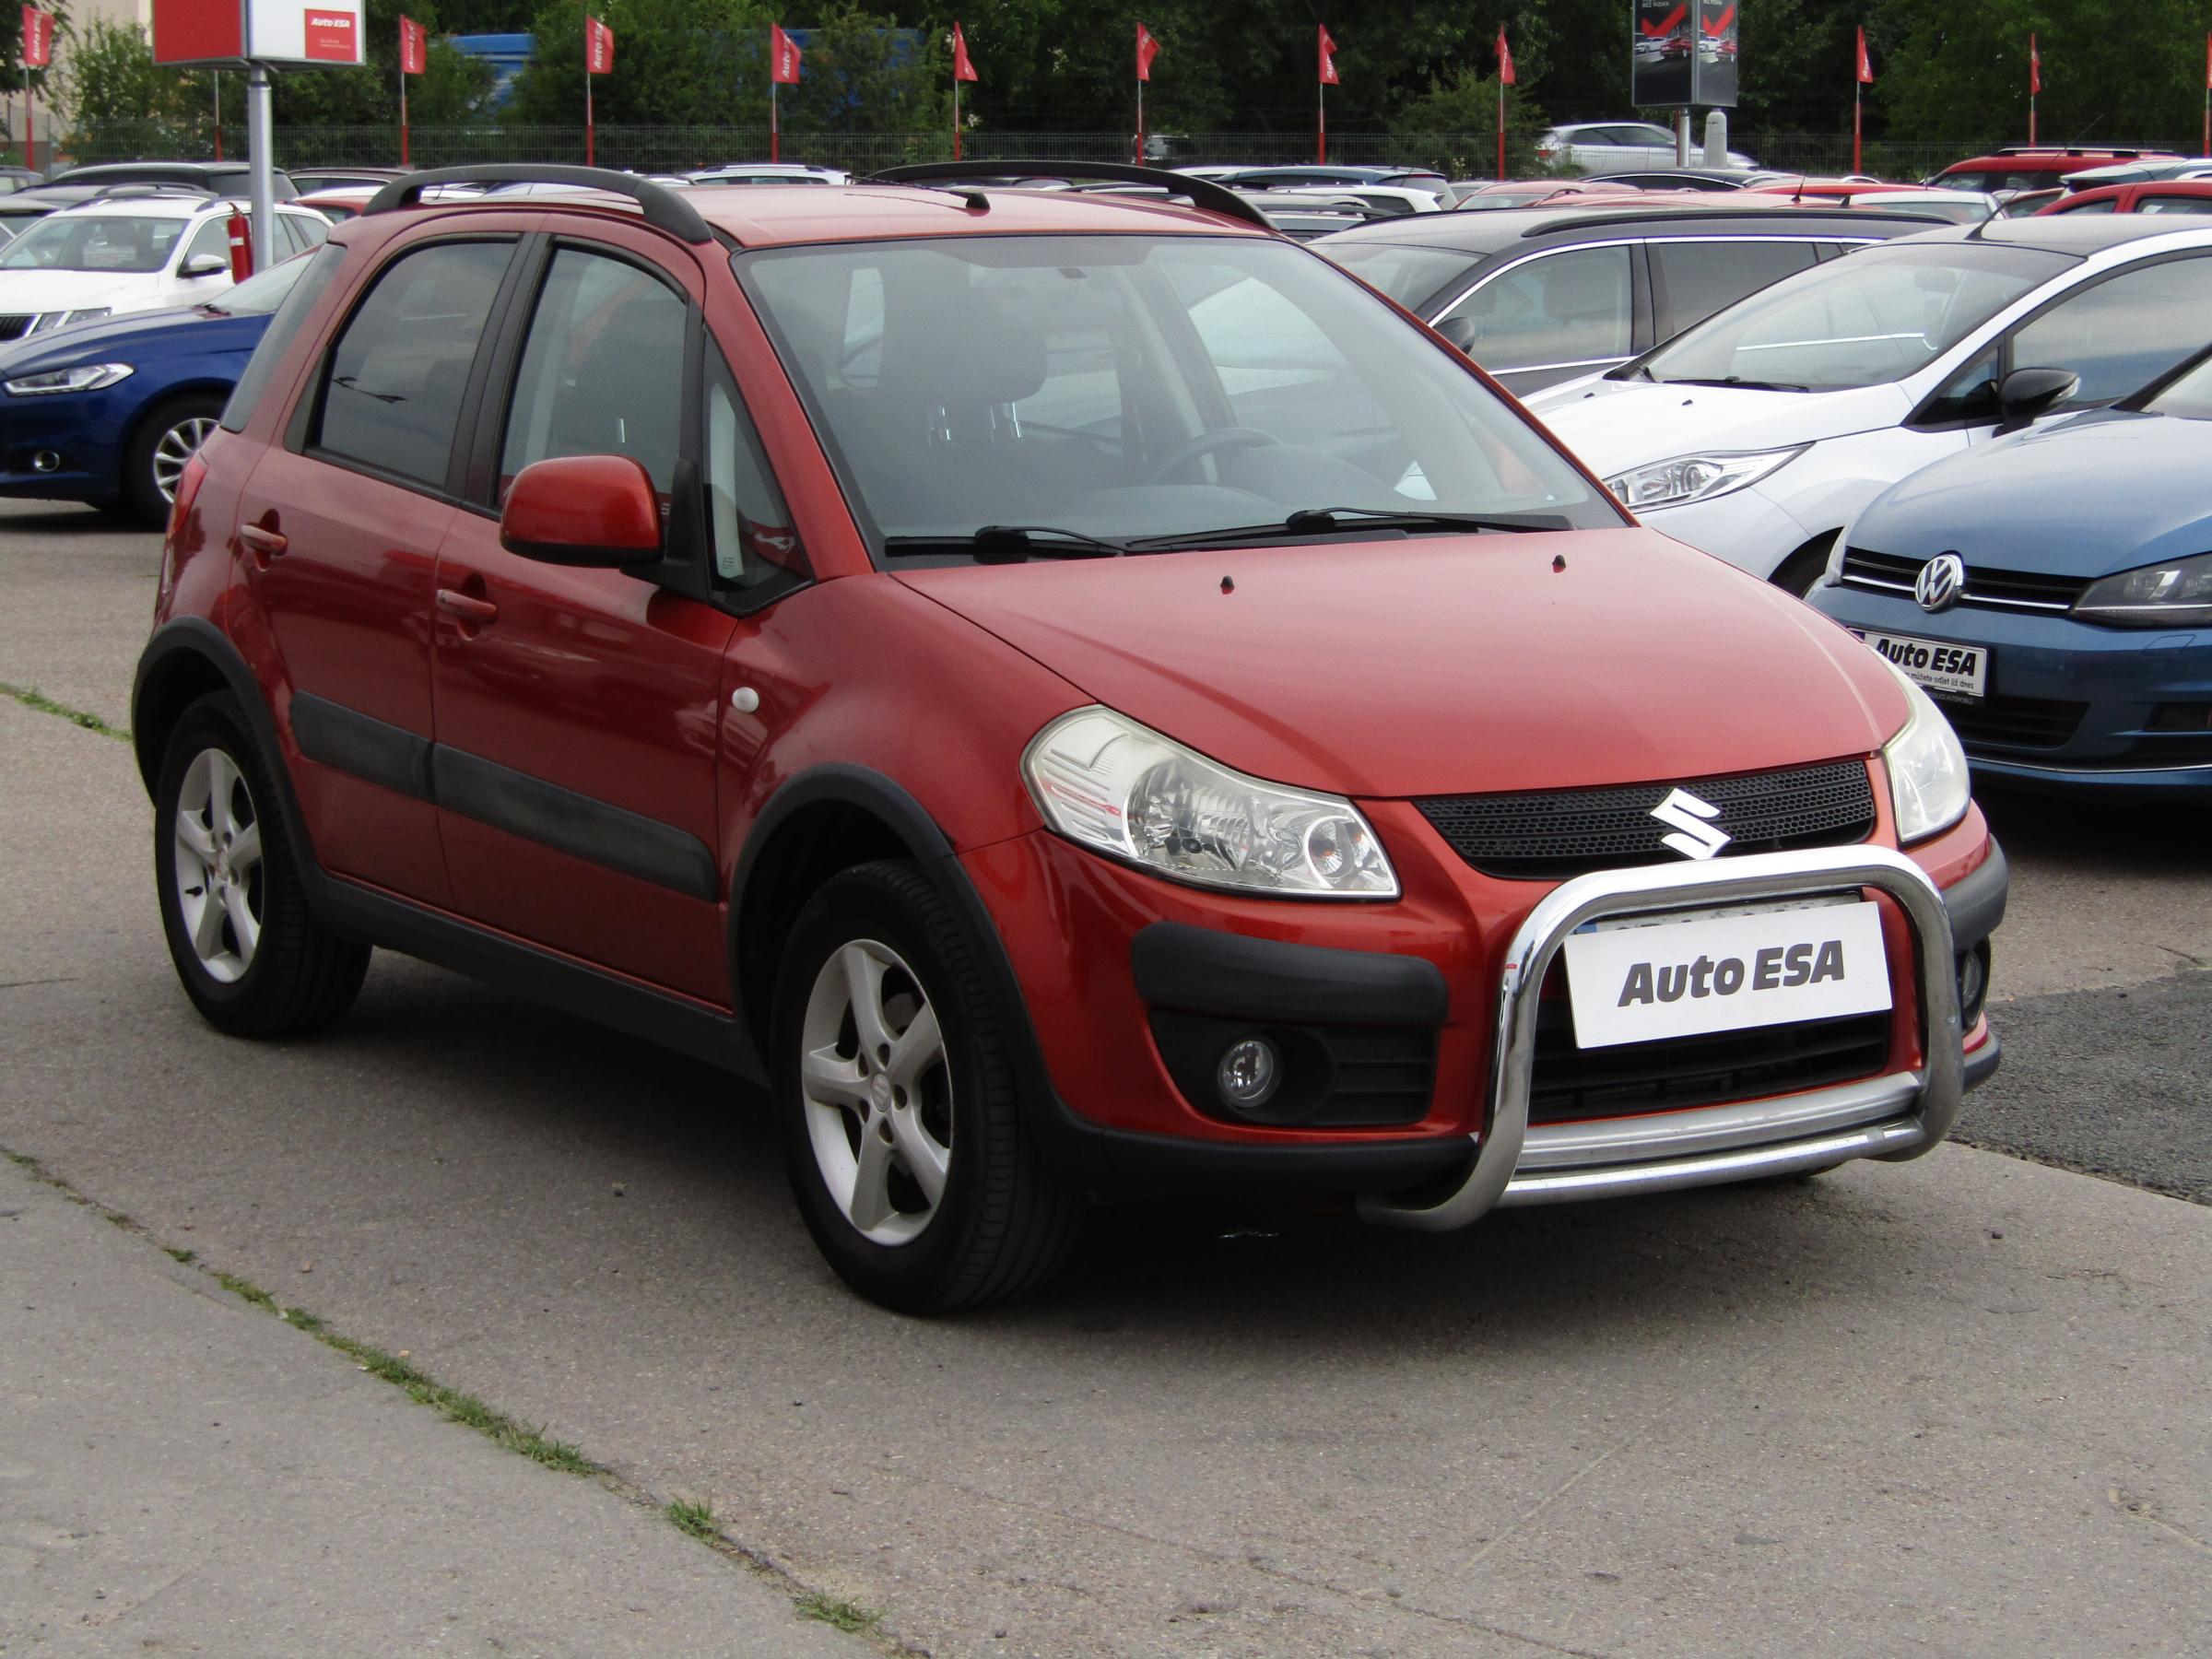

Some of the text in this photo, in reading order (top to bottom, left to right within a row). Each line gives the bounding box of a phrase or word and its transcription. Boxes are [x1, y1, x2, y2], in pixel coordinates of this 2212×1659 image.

[311, 18, 350, 28] Auto ESA
[594, 42, 603, 69] Auto
[1877, 639, 1976, 677] Auto ESA
[1934, 676, 1950, 686] odjet
[1959, 680, 1974, 688] dnes
[1618, 940, 1844, 1006] Auto ESA
